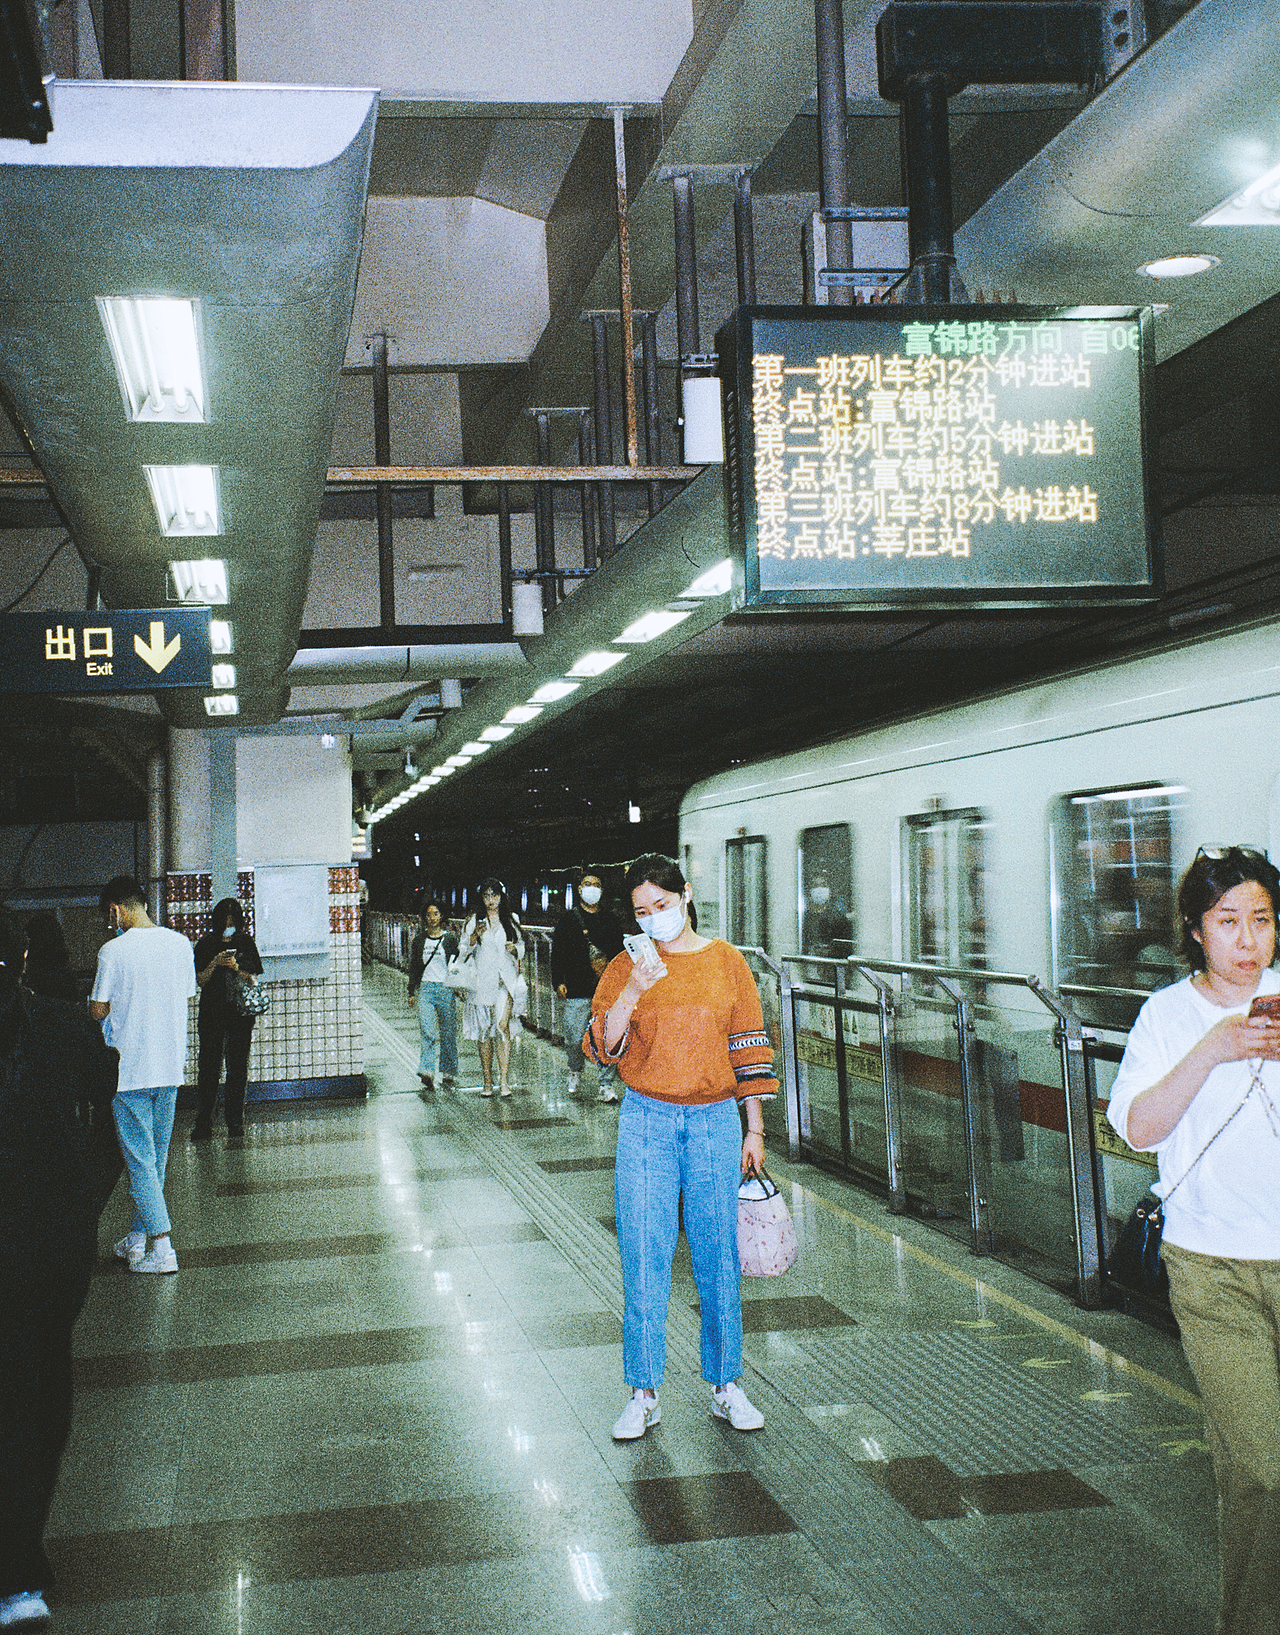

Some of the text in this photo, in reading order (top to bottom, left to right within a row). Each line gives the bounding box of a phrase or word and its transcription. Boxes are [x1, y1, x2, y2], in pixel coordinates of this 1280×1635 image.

[902, 320, 1062, 356] 富锦路方向
[752, 353, 1091, 390] 第一班列车约2分钟进站
[752, 387, 996, 425] 终点站:富锦路站
[754, 419, 1095, 458] 第二班列车约5分钟进站
[755, 454, 1000, 492] 终点站:富锦路站
[757, 485, 1098, 525] 第三班列车约8分钟进站
[758, 523, 970, 559] 终点站:莘庄站
[45, 625, 113, 660] 出口
[86, 662, 113, 676] Exit
